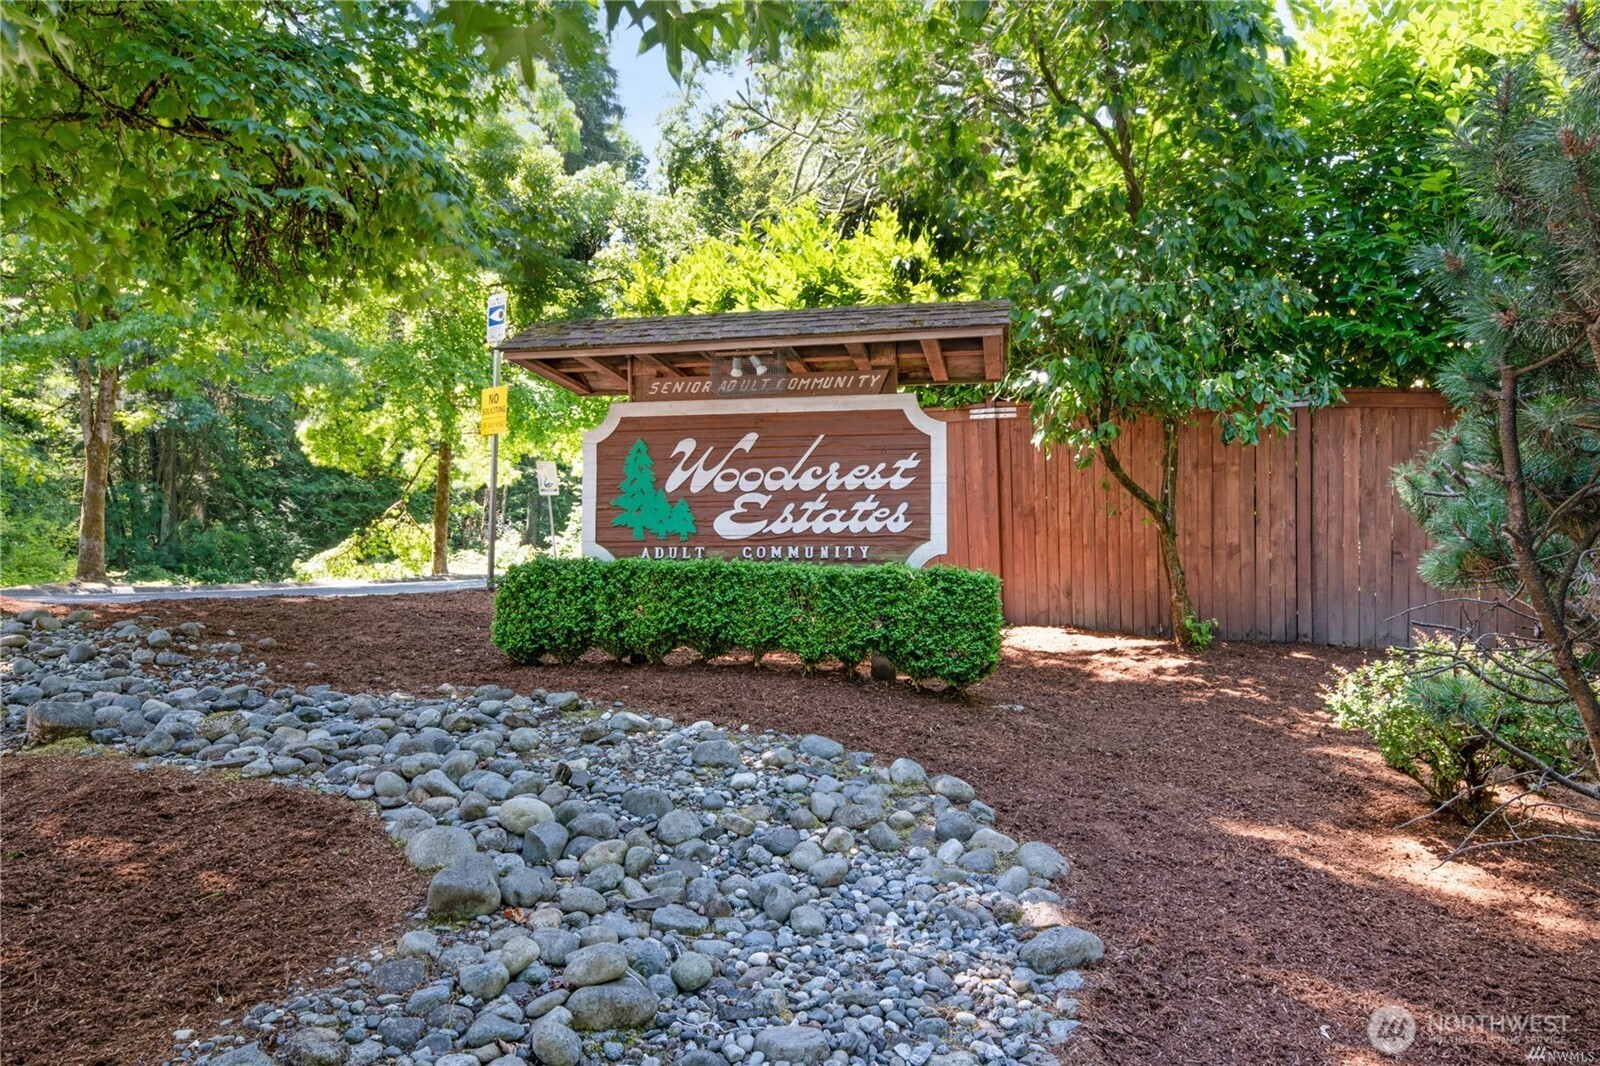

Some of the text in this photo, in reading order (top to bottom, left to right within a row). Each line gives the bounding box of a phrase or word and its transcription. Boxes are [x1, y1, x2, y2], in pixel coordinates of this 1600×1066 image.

[649, 374, 881, 395] SENIOR ADULT COMMUNITY
[488, 393, 499, 405] NO
[482, 405, 506, 415] SOLICITING
[665, 432, 921, 493] Woodcrest
[713, 493, 913, 540] Estates
[640, 546, 870, 559] ADULT COMMUNITY
